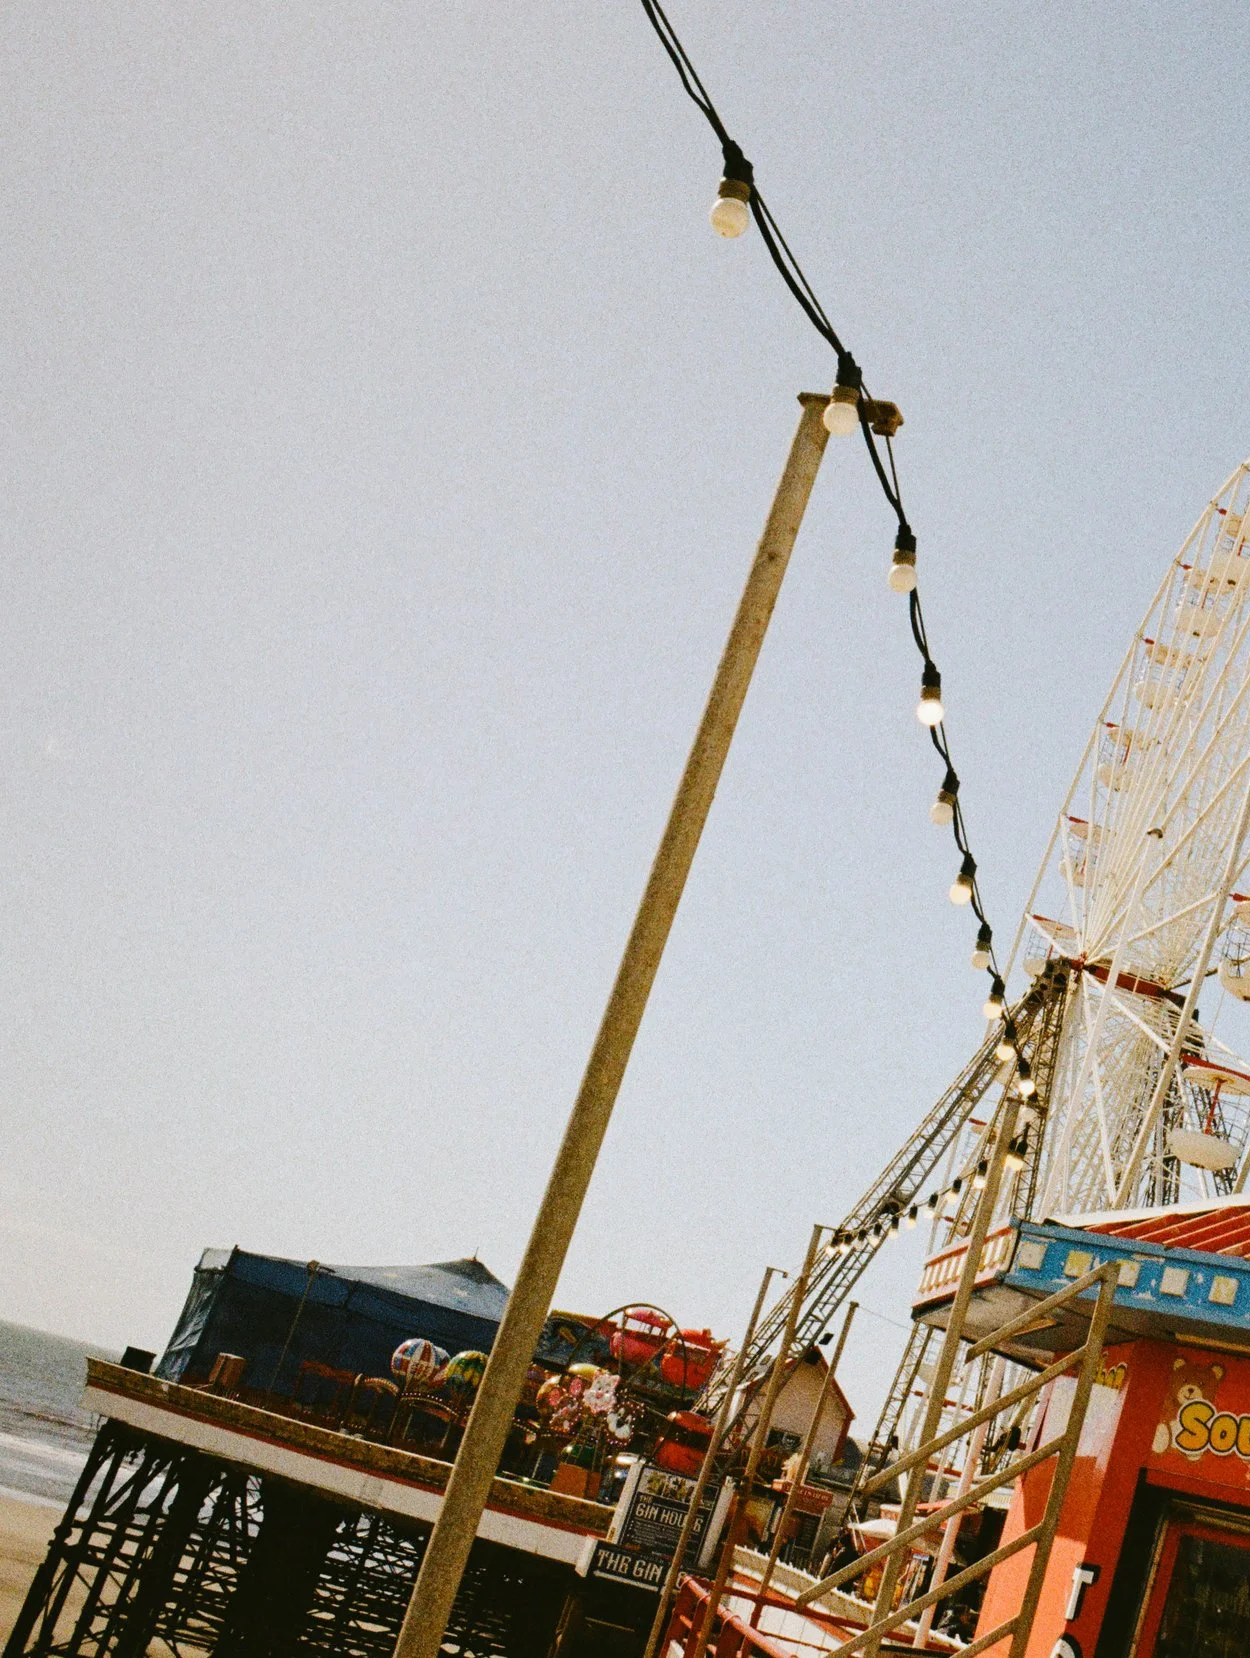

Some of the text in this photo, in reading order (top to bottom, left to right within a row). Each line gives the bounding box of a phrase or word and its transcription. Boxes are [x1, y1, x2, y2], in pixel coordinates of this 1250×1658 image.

[635, 1503, 704, 1533] GIN HOUE
[597, 1549, 631, 1574] THE
[633, 1559, 664, 1583] GIN
